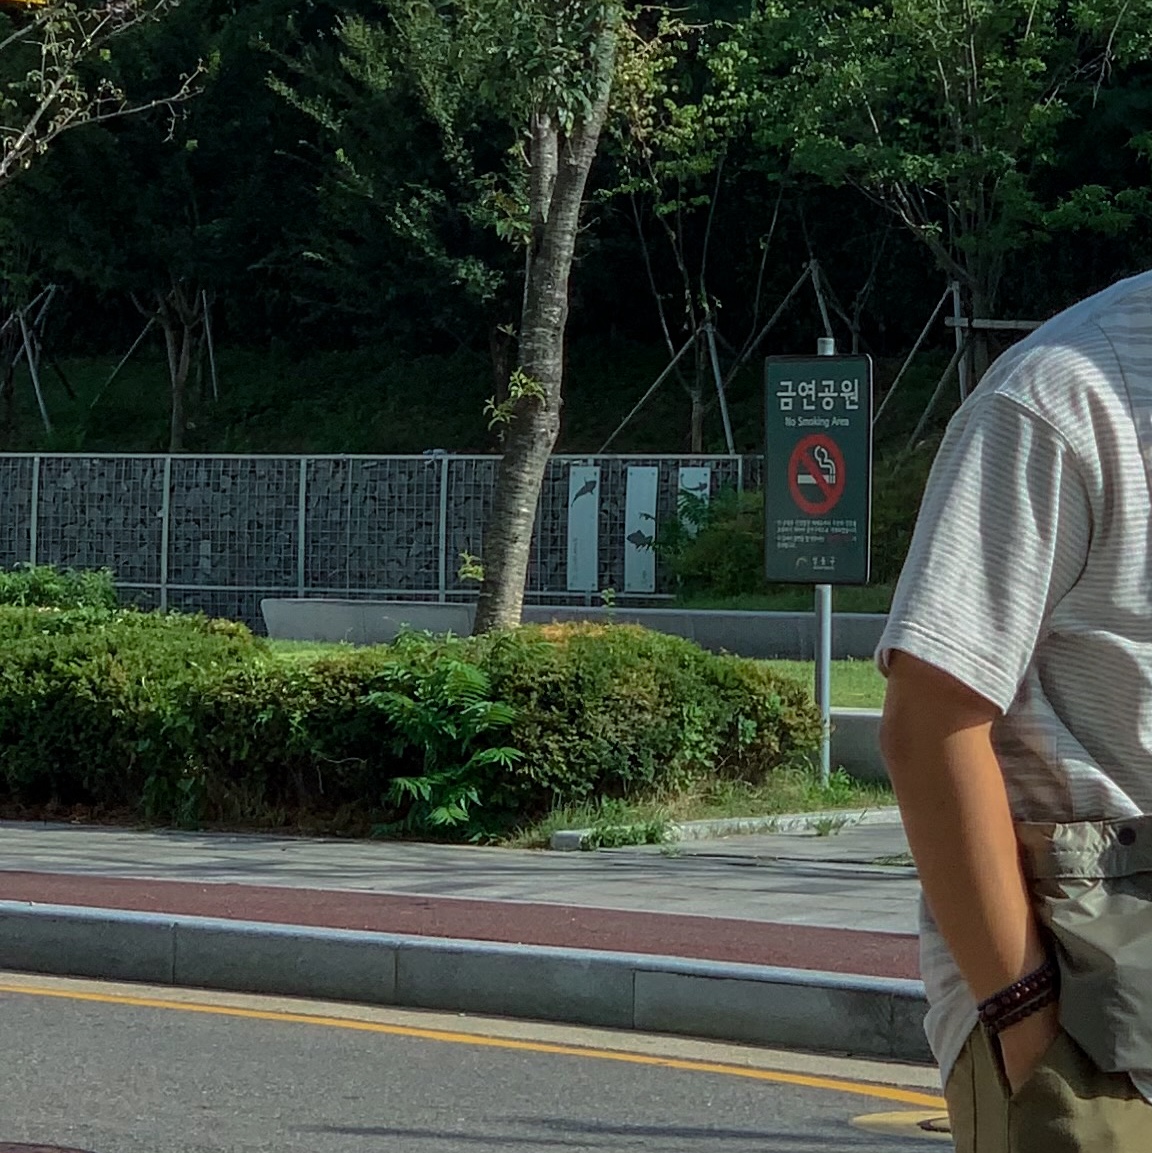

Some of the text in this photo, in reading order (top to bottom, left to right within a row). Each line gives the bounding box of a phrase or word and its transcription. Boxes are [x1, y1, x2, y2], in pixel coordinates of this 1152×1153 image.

[776, 379, 859, 410] 금연공원
[785, 416, 850, 428] No Smoking Area
